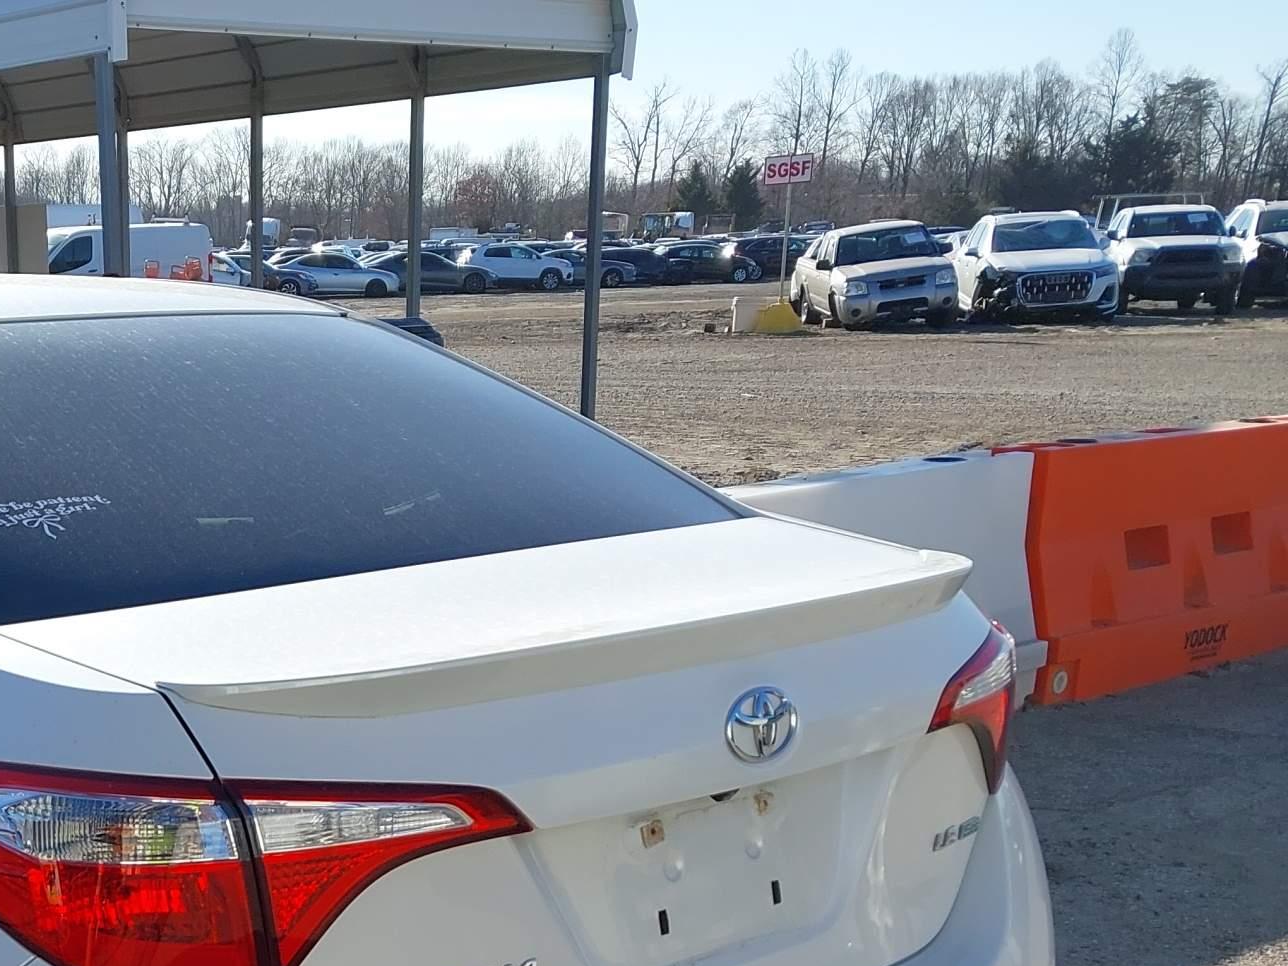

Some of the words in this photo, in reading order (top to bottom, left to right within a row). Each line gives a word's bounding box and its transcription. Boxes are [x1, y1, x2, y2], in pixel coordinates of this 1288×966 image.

[767, 160, 811, 179] SGSF
[8, 501, 33, 512] be
[5, 508, 42, 527] just
[43, 507, 56, 515] a
[1184, 622, 1229, 649] YODOCK
